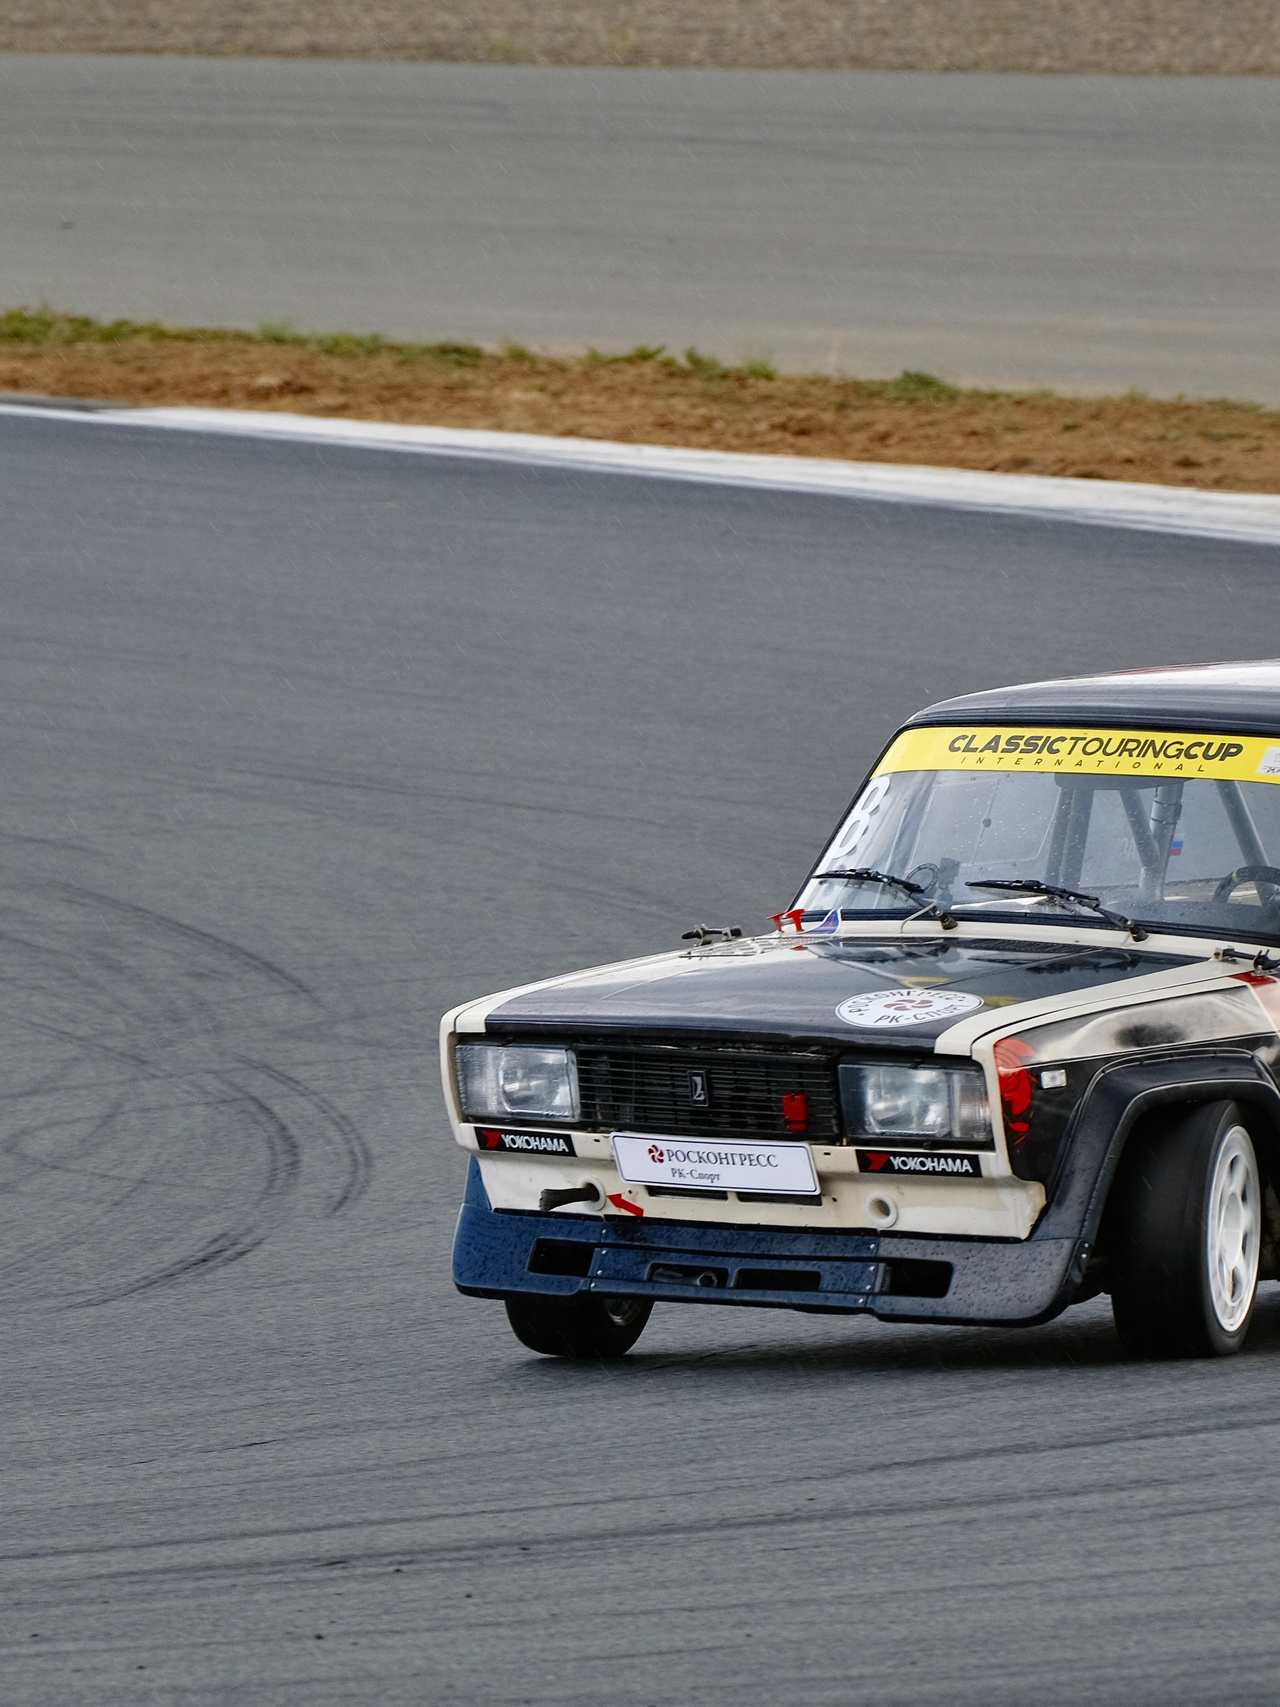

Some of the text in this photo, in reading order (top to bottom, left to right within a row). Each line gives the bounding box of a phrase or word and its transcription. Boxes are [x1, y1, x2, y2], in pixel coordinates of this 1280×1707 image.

[961, 756, 1205, 773] INTERNATIONAL
[501, 1133, 569, 1153] YOKOHAMA
[666, 1149, 779, 1168] РОСКОНГРЕСС
[889, 1156, 974, 1173] YOKOHAMA
[671, 1167, 720, 1183] РК-Спорт
